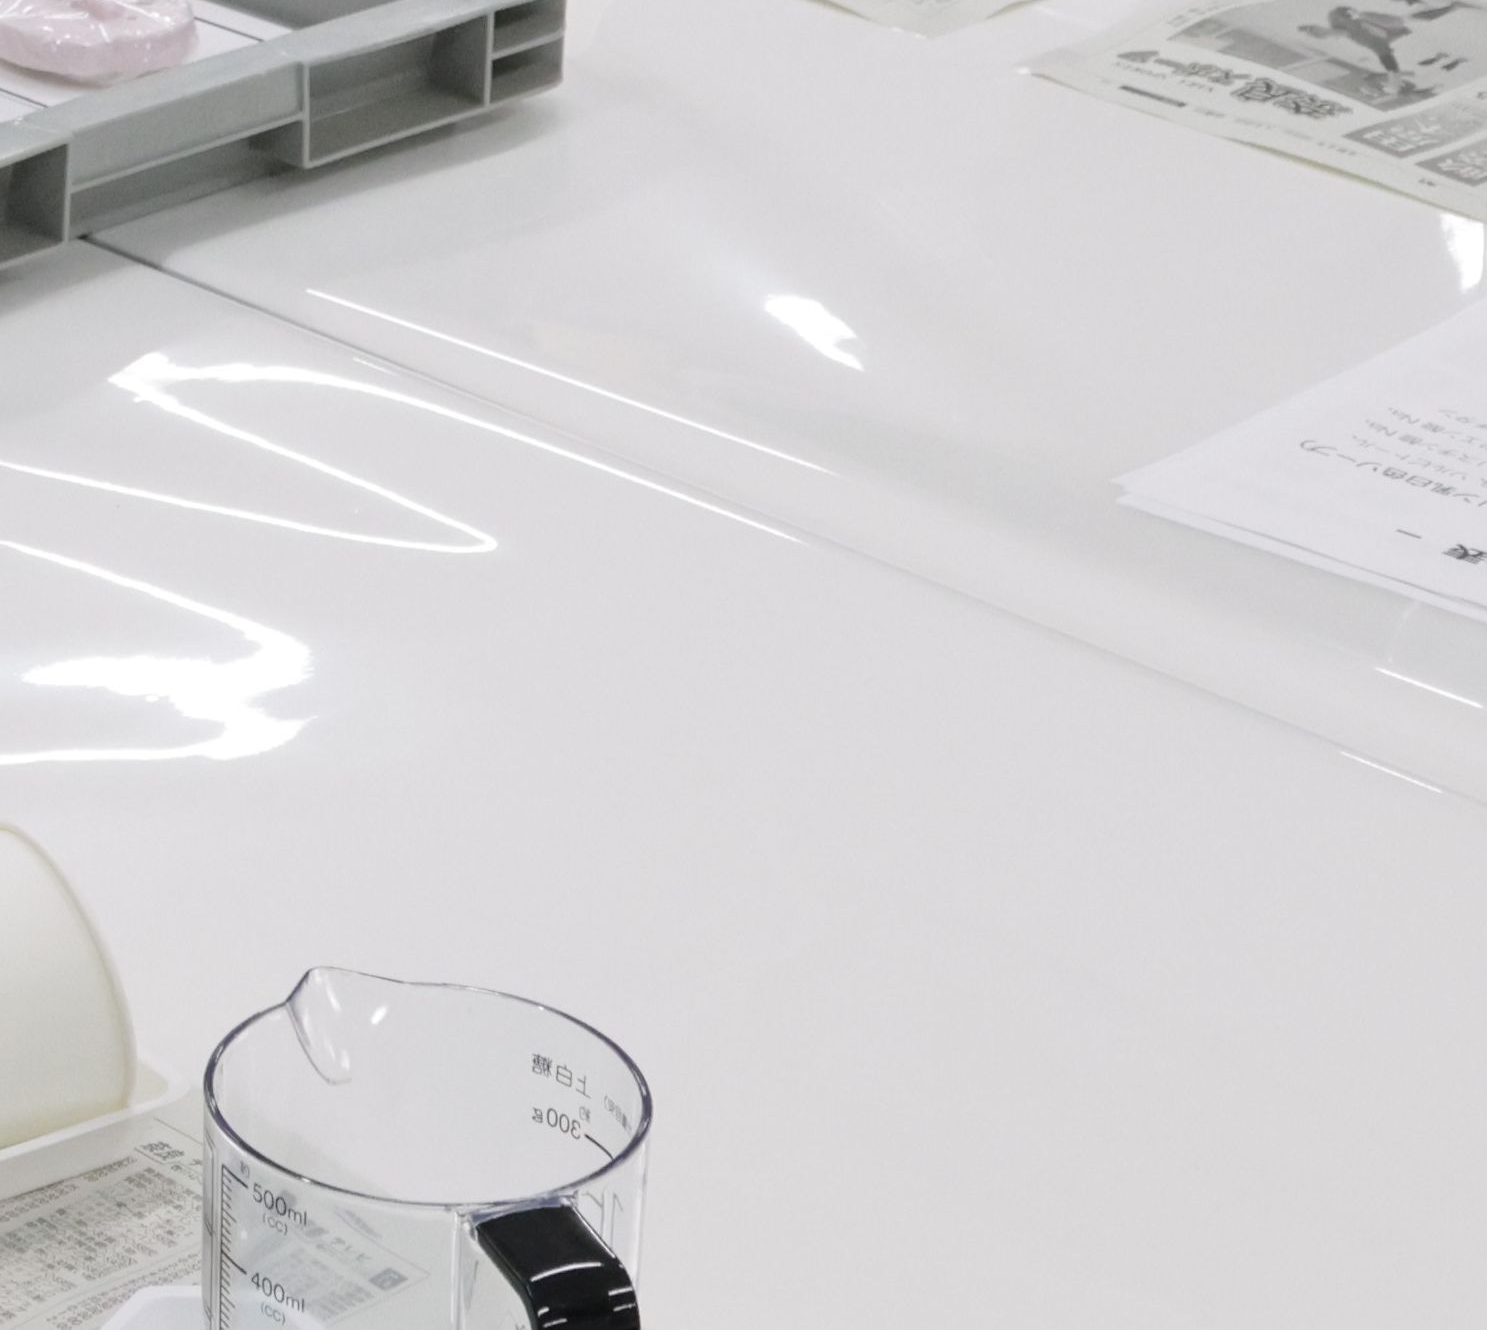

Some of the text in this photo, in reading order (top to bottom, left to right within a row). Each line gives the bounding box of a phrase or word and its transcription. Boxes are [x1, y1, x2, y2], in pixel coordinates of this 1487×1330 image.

[252, 1182, 308, 1227] 500ml
[262, 1214, 289, 1237] (CC)
[250, 1271, 306, 1314] 400ml
[260, 1301, 287, 1325] (CC)
